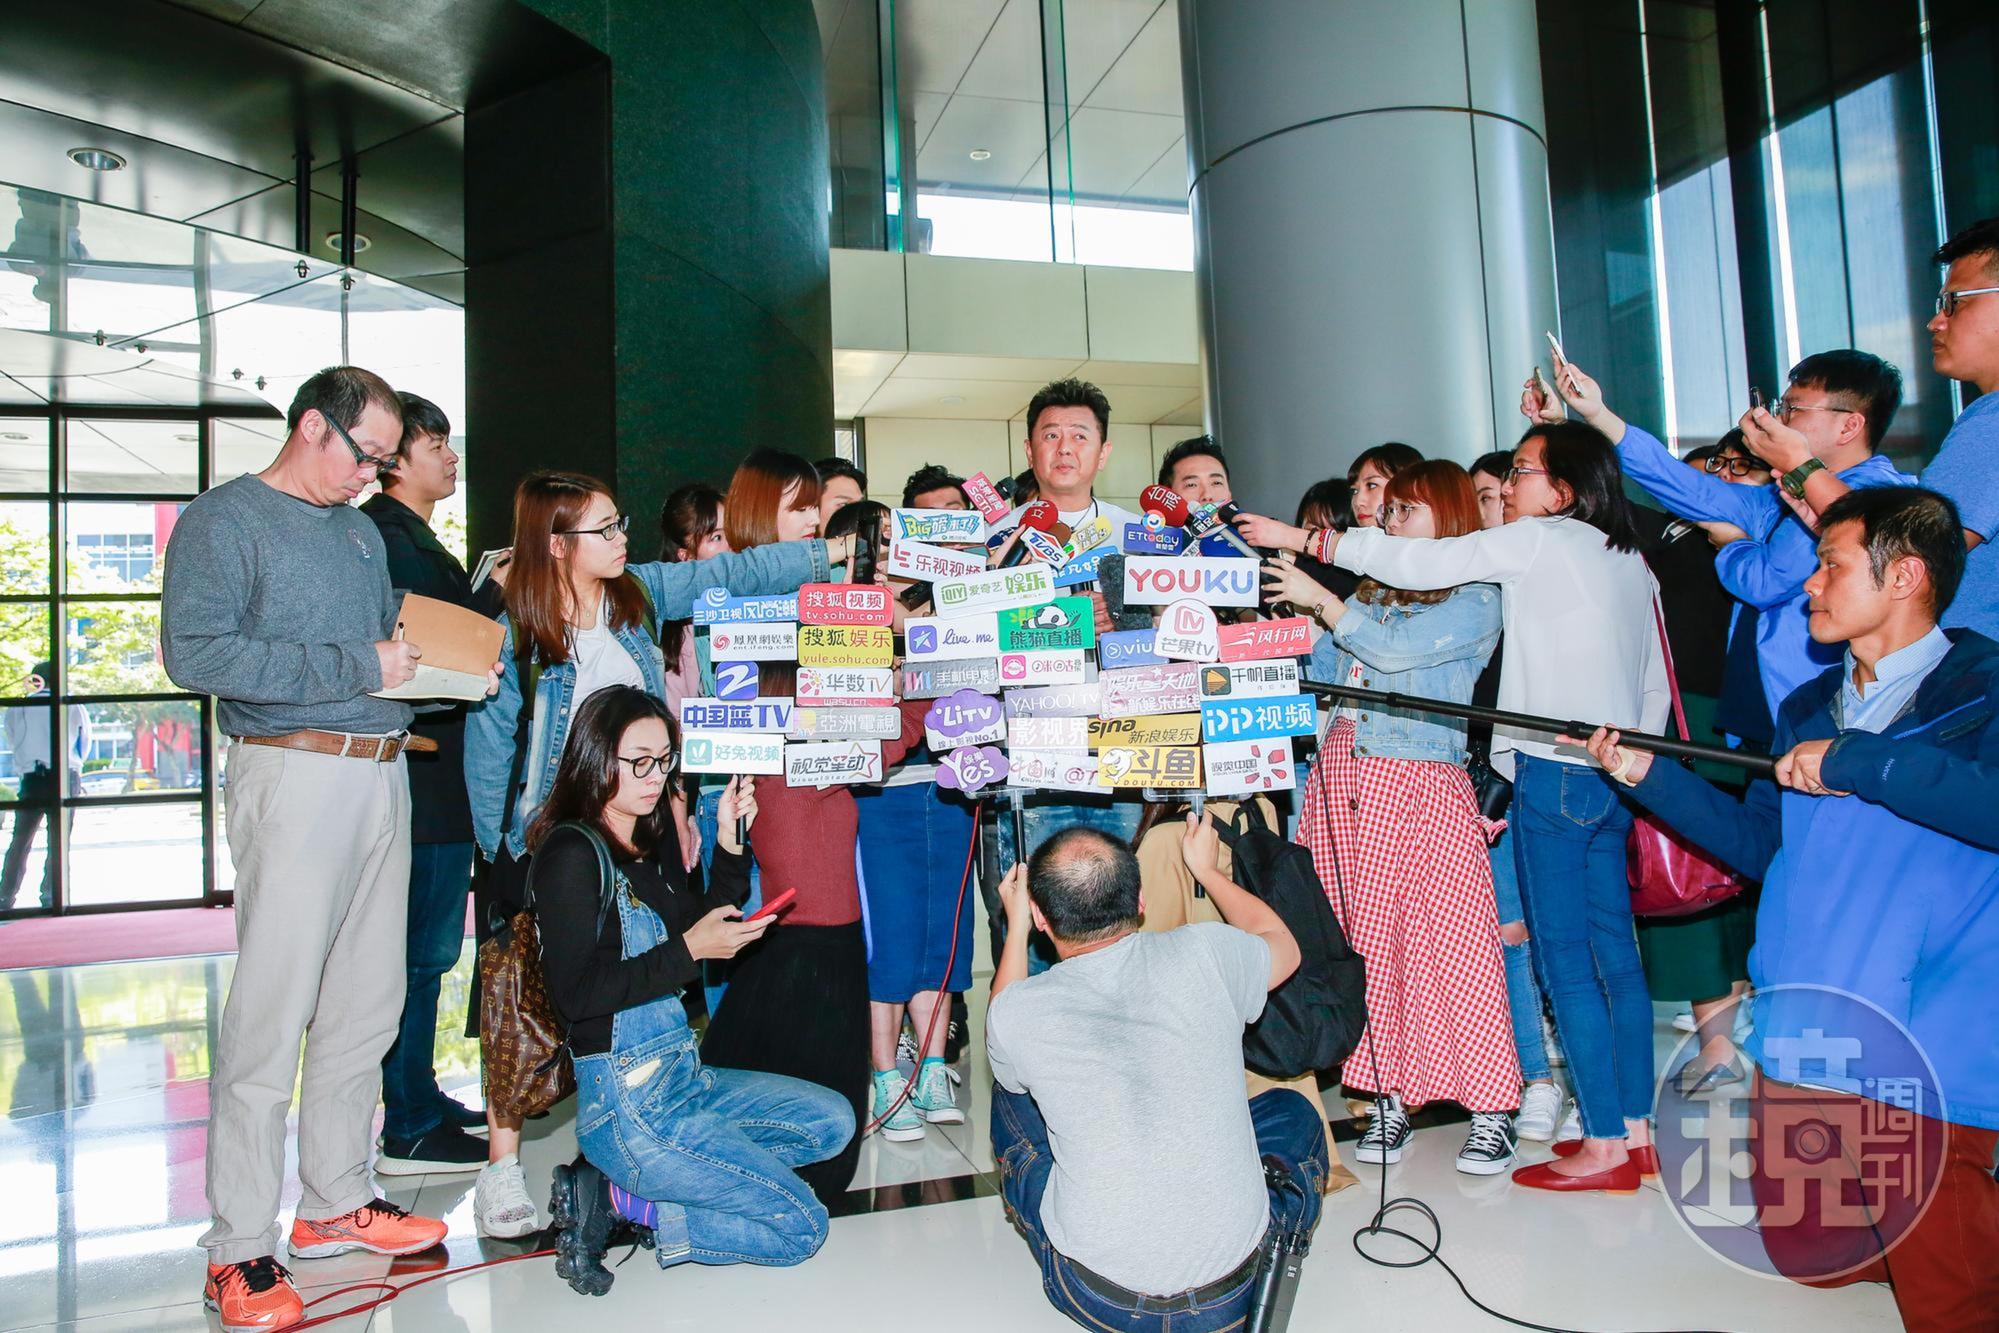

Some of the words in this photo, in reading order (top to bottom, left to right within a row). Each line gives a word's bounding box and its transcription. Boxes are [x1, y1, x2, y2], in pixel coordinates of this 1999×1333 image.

[1147, 486, 1182, 510] 台視
[1028, 532, 1063, 562] TVBS
[1127, 531, 1180, 546] ETtoday
[1129, 569, 1253, 594] YOUKU
[805, 591, 883, 608] 搜狐视频
[805, 611, 885, 620] tv.sohu.com
[804, 629, 890, 648] 搜狐娱乐
[1010, 630, 1082, 649] 熊猫直播
[1256, 625, 1307, 645] 风行网
[1160, 637, 1215, 658] 芒果tv
[803, 652, 890, 665] yule.sohu.com
[826, 673, 891, 693] 华数TV
[1232, 665, 1296, 682] 千帆直播
[1010, 690, 1075, 712] YAHOO!
[683, 705, 790, 728] 中国蓝TV
[820, 713, 895, 733] 亞洲電視
[1206, 703, 1313, 736] PP视频
[1014, 716, 1087, 745] 影视界
[1088, 718, 1137, 739] sina
[1128, 728, 1194, 745] 新浪娱乐
[715, 745, 780, 761] 好兔视频
[937, 751, 994, 789] Yes
[1130, 748, 1195, 780] 斗鱼
